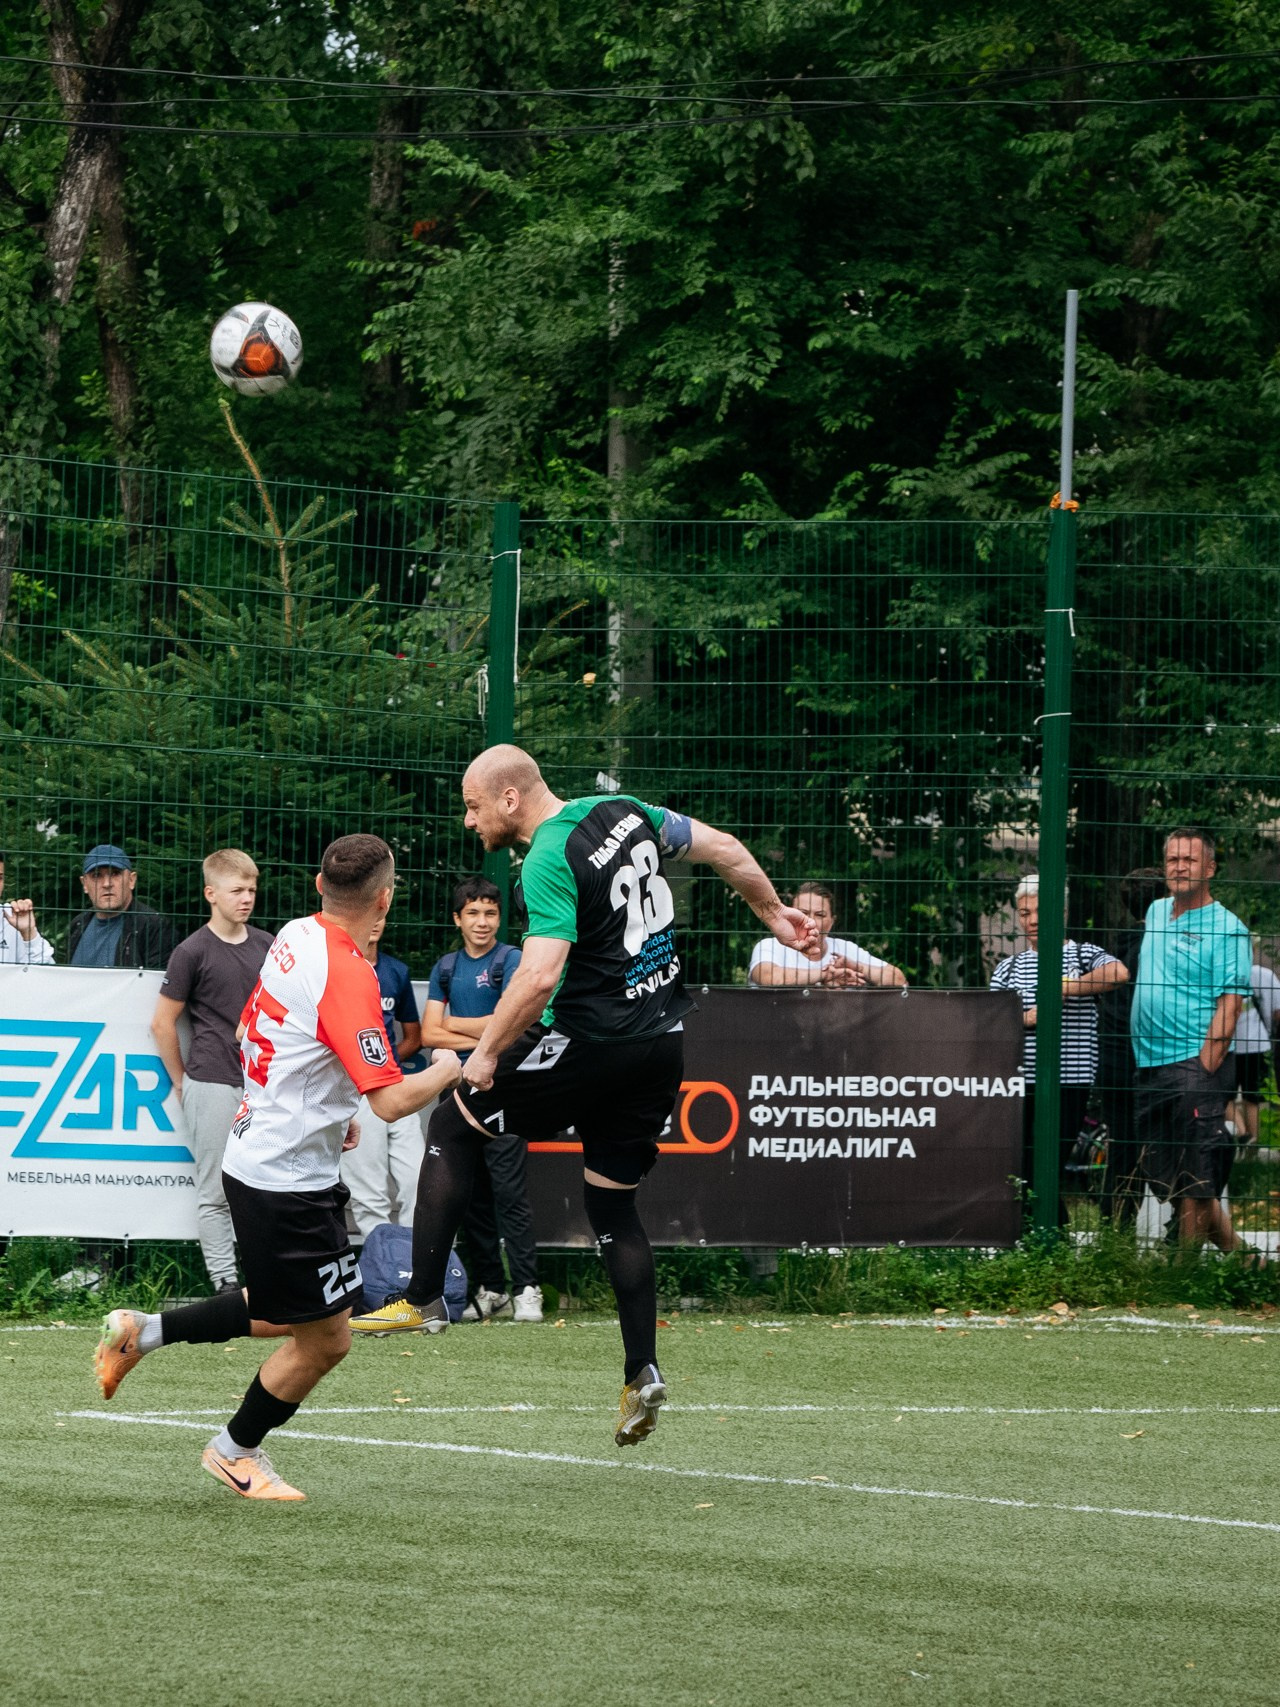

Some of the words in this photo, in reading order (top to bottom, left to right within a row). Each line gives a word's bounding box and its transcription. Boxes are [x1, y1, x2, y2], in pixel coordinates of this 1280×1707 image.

[610, 840, 675, 957] 23
[240, 986, 290, 1088] 5
[748, 1075, 1026, 1100] ДАЛЬНЕВОСТОЧНАЯ
[749, 1104, 936, 1128] ФУТБОЛЬНАЯ
[748, 1137, 916, 1162] МЕДИАЛИГА
[7, 1171, 91, 1185] МЕБЕЛЬНАЯ
[95, 1174, 196, 1188] МАНУФАКТУРА
[318, 1253, 363, 1305] 25
